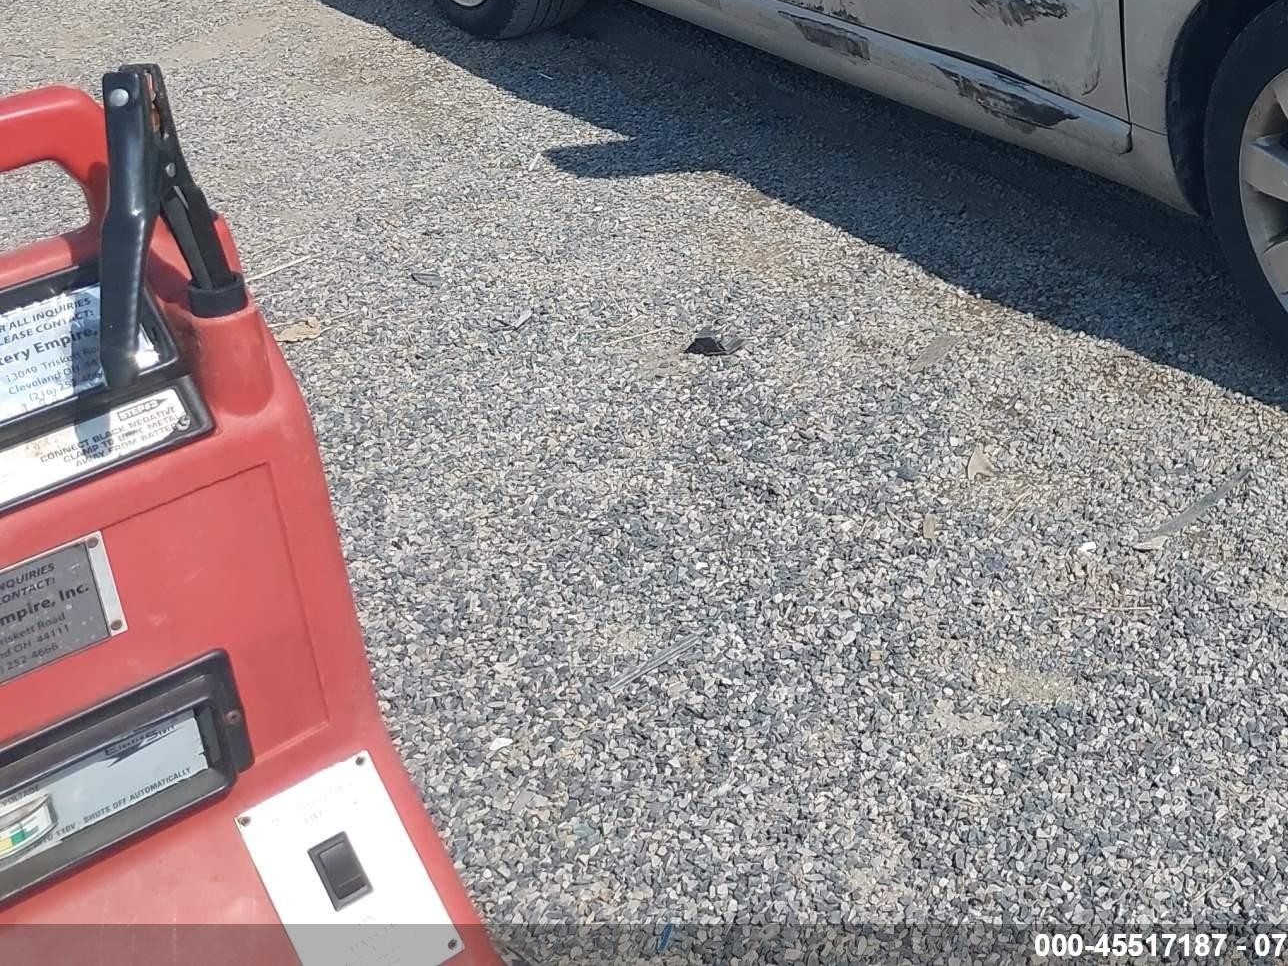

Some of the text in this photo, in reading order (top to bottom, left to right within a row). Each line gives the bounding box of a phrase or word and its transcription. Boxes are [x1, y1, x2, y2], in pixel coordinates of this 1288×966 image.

[0, 328, 33, 347] LEASE
[35, 309, 94, 334] CONTACT:
[9, 317, 31, 331] ALL
[32, 297, 91, 322] INQUIRIES
[34, 327, 98, 354] Empire,
[39, 437, 91, 463] CONNECT
[92, 425, 126, 443] BLACK
[127, 406, 176, 430] NEGATIVE
[63, 445, 99, 464] CLAMP
[103, 438, 115, 448] TO
[75, 450, 106, 467] AWAY
[108, 438, 138, 454] FROM
[0, 562, 56, 592] NQUIRIES
[0, 577, 56, 605] ONTACT:
[0, 583, 90, 627] mpire, Inc.
[0, 611, 66, 646] riskett Road
[14, 640, 32, 653] OH
[1, 784, 40, 807] VOLTAGE
[83, 806, 111, 823] SHUTS
[112, 797, 127, 810] OFF
[129, 766, 192, 802] AUTOMATICALLY
